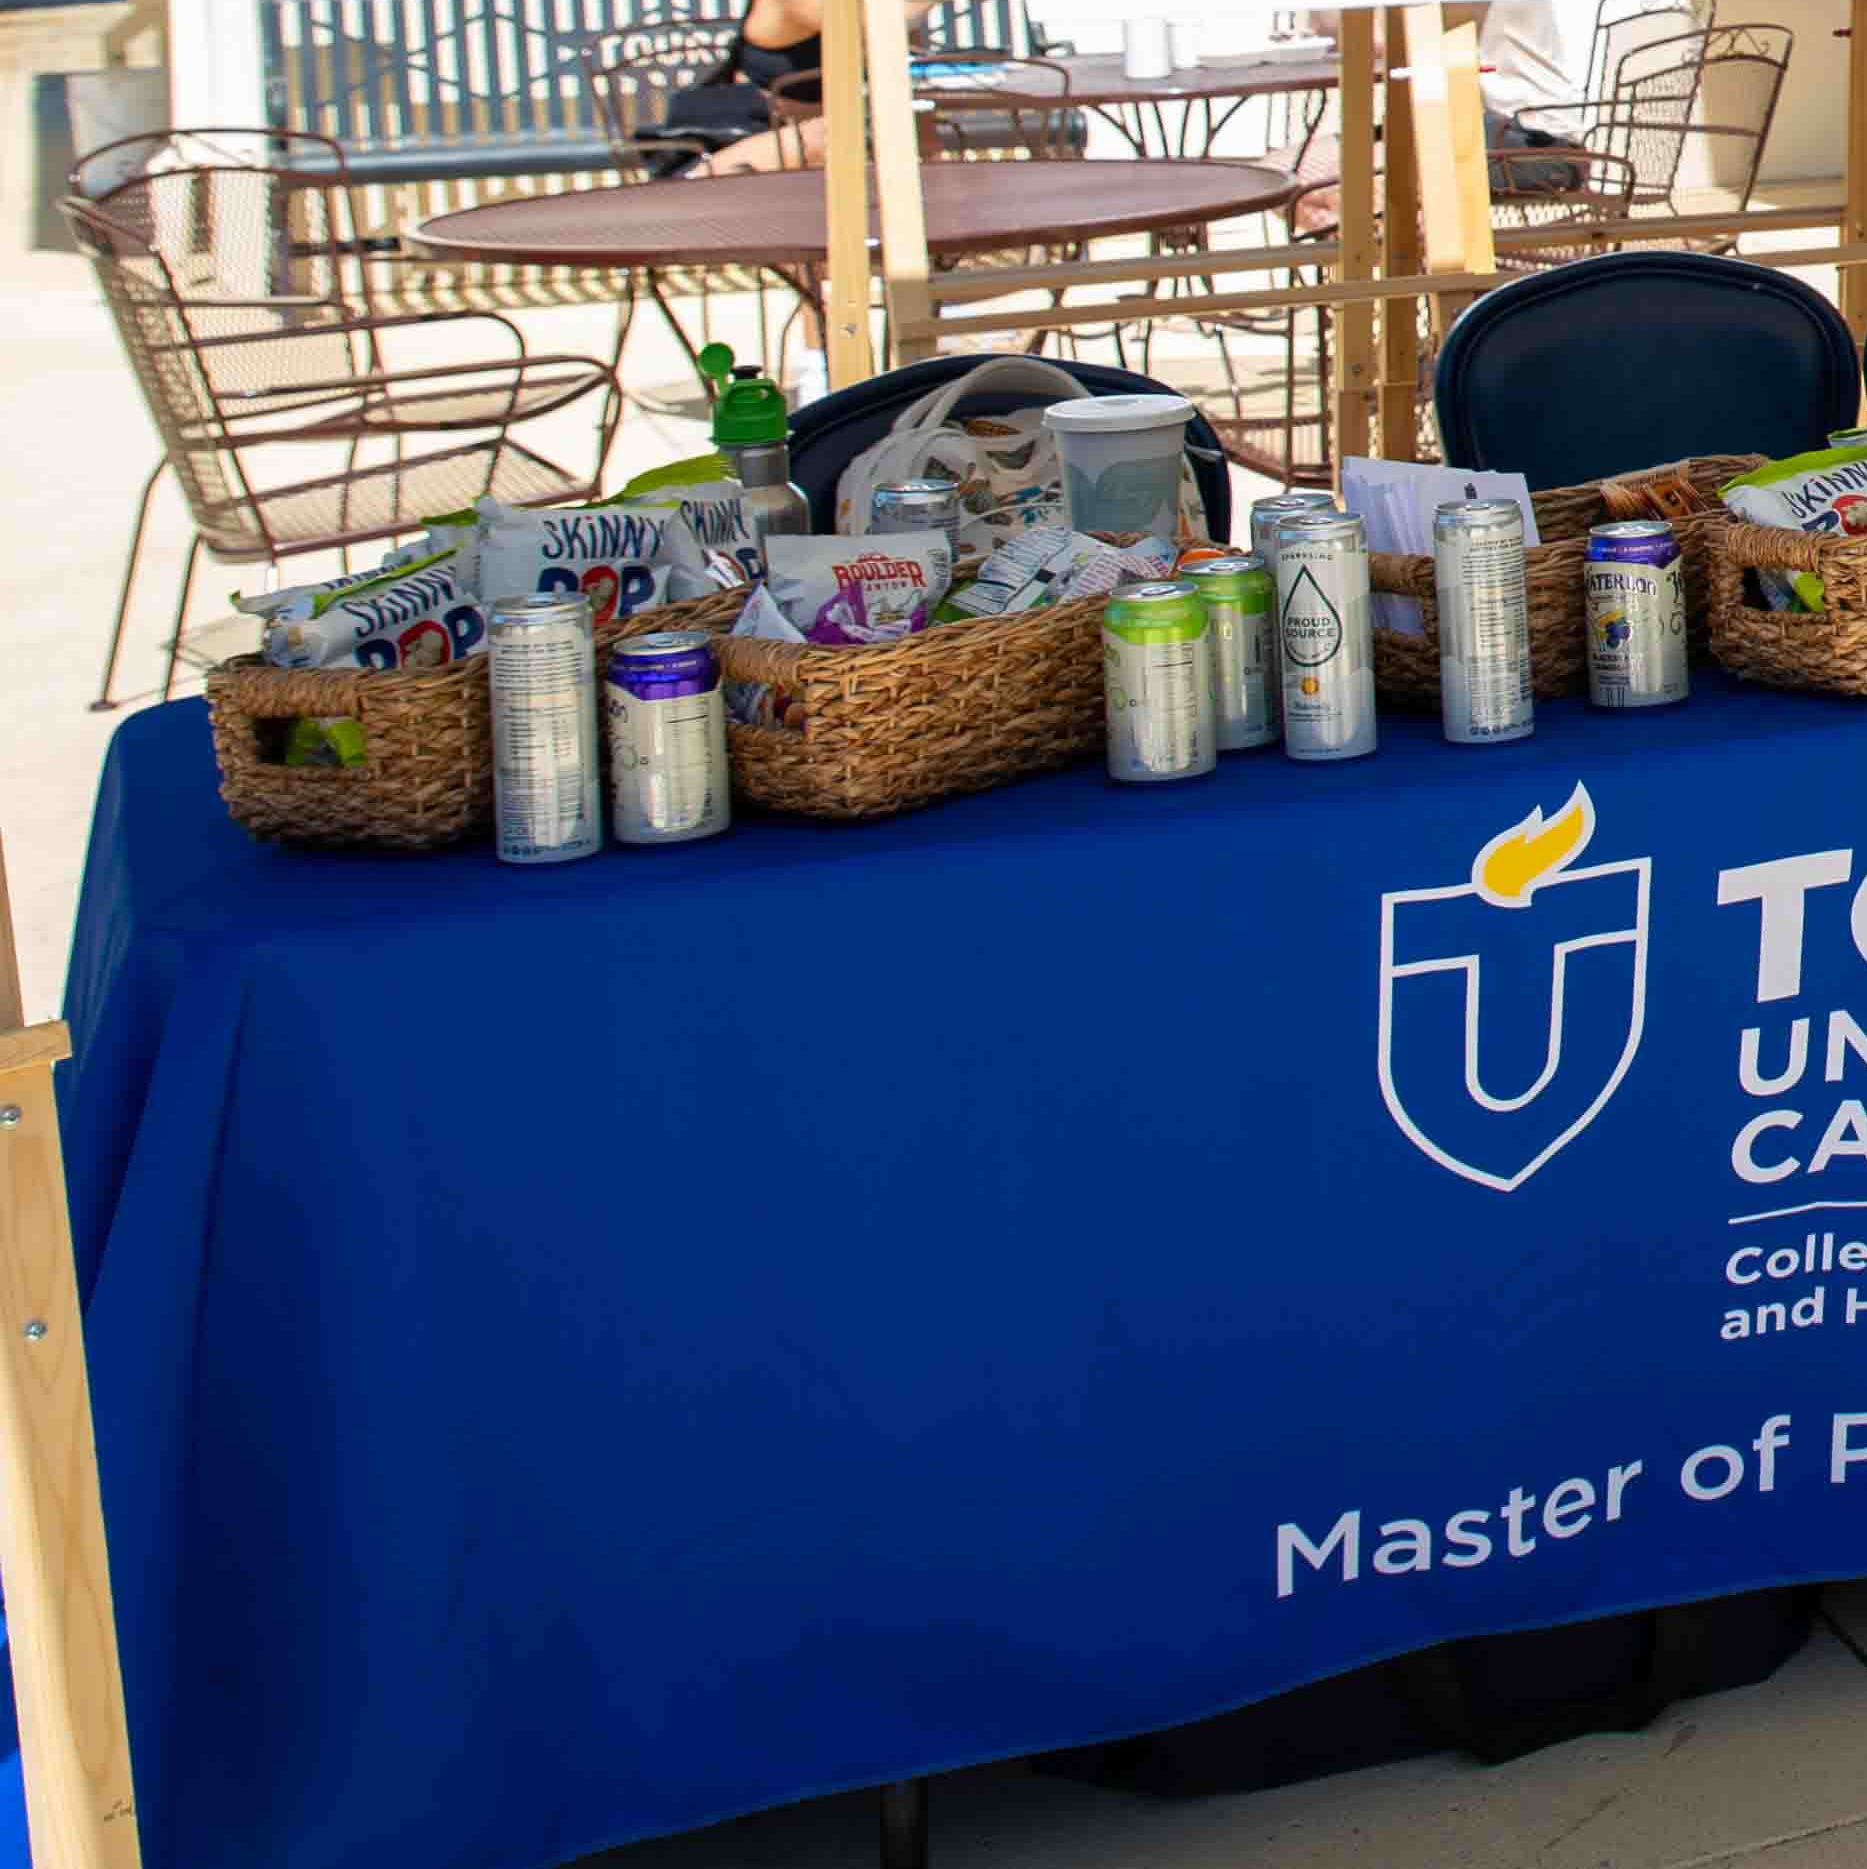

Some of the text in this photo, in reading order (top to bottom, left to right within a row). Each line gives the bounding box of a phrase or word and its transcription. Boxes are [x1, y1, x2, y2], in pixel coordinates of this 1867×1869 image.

[1720, 1287, 1824, 1339] and
[1278, 1461, 1642, 1598] Master
[1681, 1415, 1790, 1500] of
